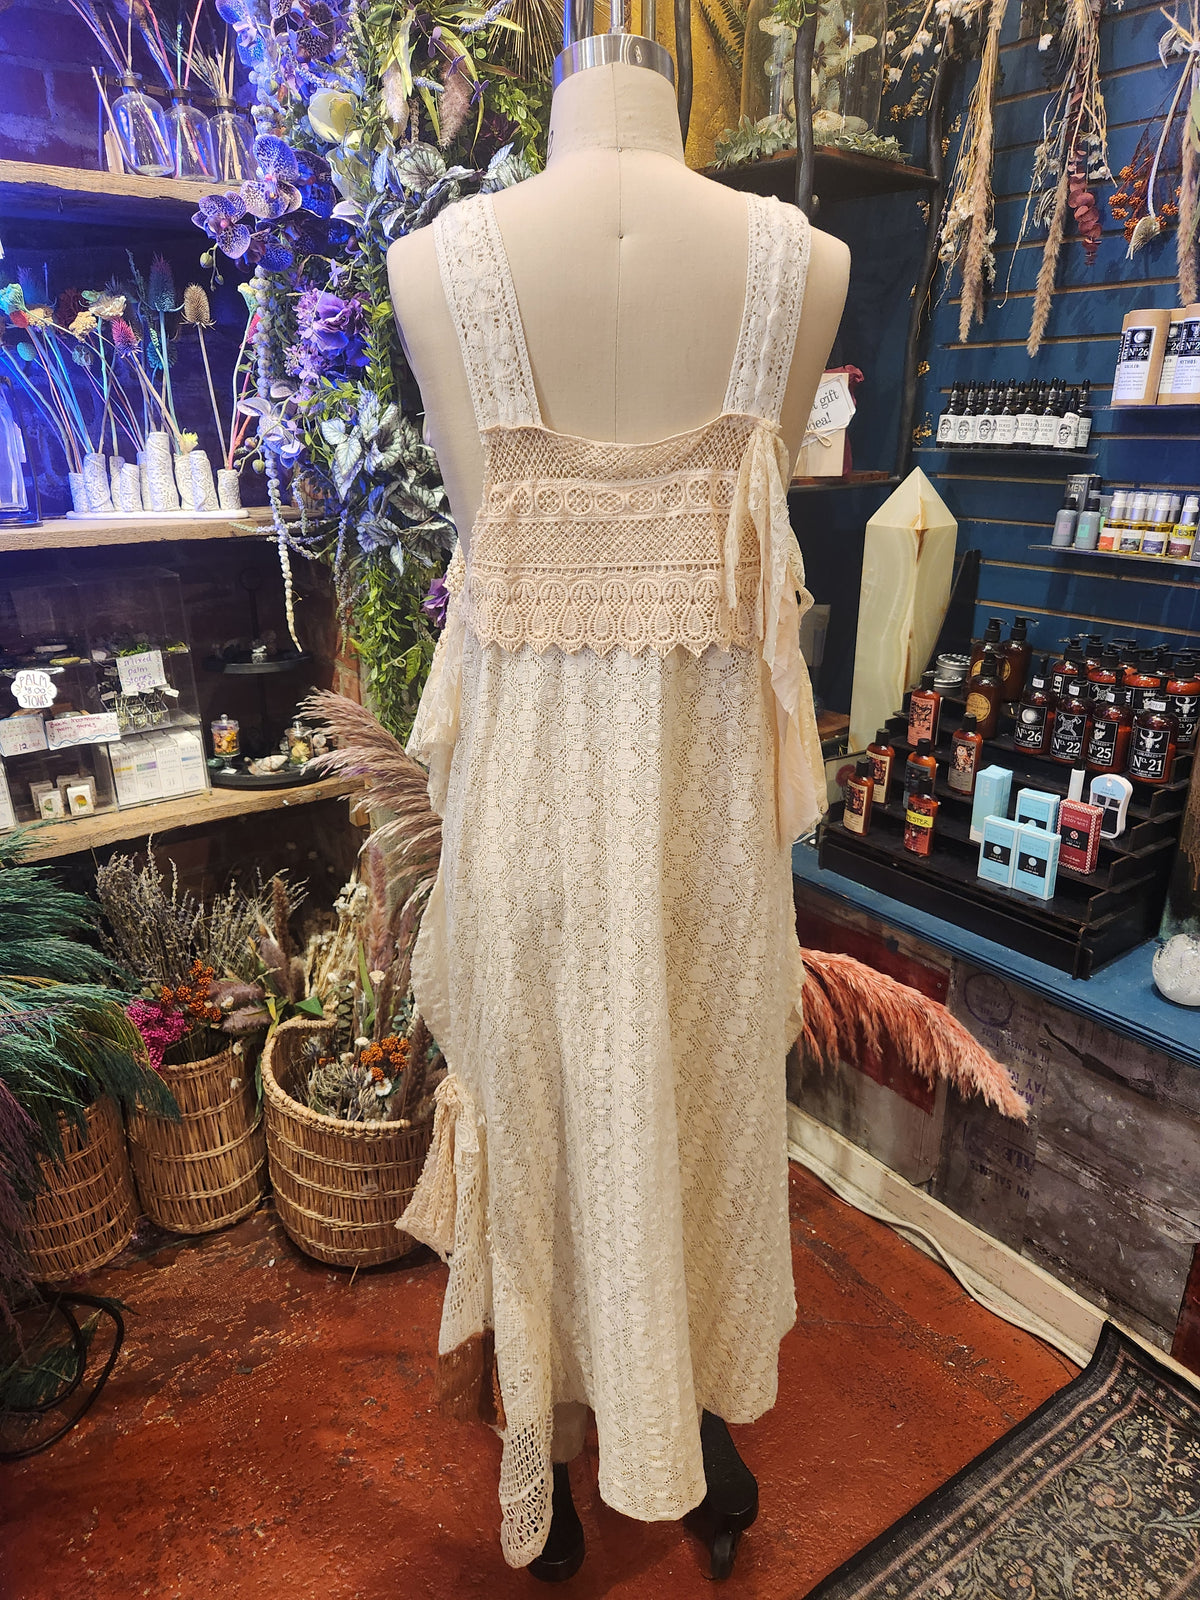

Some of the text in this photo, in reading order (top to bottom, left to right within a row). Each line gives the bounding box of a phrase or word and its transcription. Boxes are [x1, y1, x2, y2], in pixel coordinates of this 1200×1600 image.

[819, 389, 839, 409] gift
[1067, 483, 1085, 493] MEN
[20, 673, 47, 688] PALM
[1027, 730, 1042, 742] 26
[1066, 741, 1081, 754] 22
[1097, 746, 1111, 759] 25
[1147, 759, 1162, 772] 21
